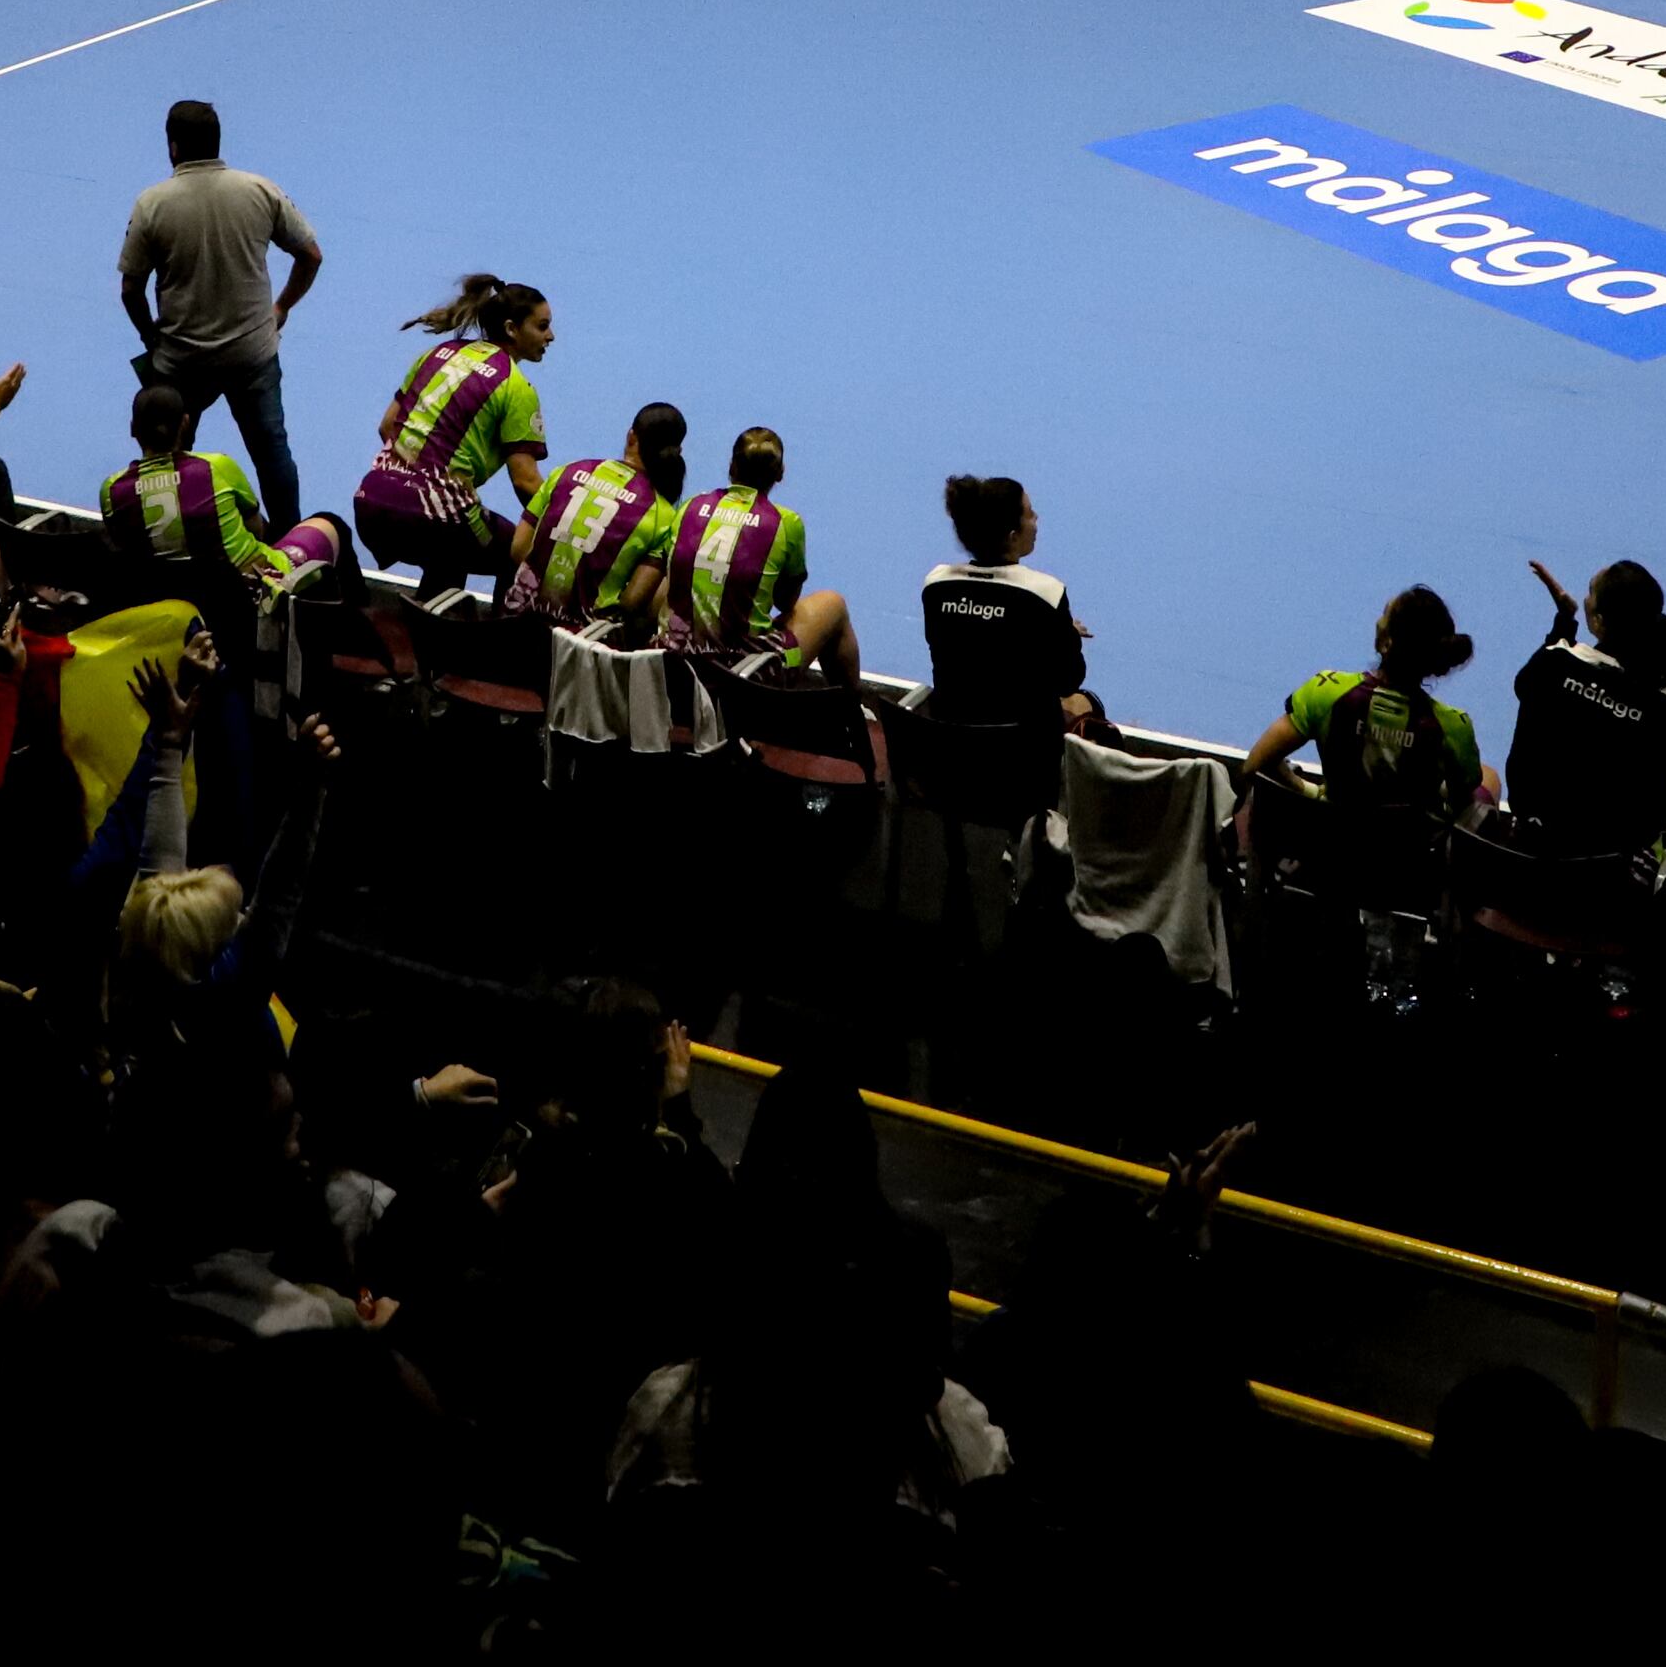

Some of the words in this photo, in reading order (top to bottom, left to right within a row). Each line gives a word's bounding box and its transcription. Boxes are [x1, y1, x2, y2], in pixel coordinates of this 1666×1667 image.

[572, 469, 638, 505] CUADRADO
[548, 485, 621, 554] 13
[693, 523, 743, 585] 4
